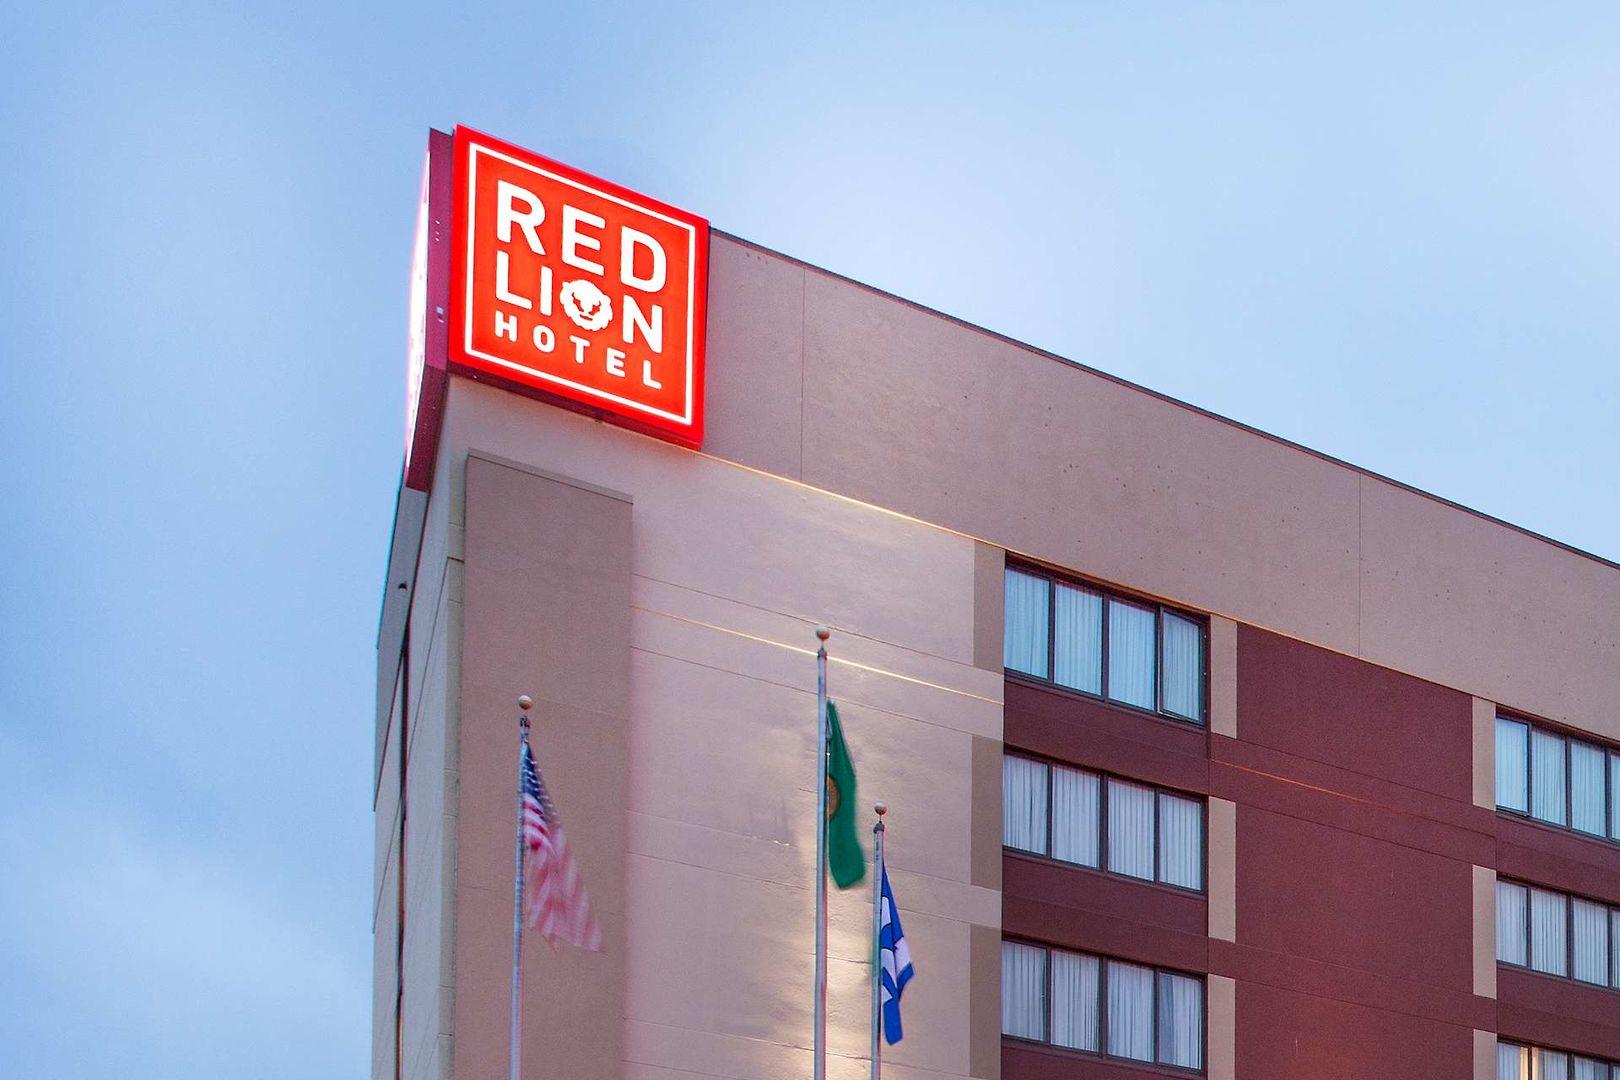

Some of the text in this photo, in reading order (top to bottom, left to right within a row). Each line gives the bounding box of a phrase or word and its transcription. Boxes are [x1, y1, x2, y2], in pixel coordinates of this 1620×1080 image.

[496, 180, 667, 293] RED
[495, 311, 662, 389] HOTEL
[496, 250, 663, 353] LION
